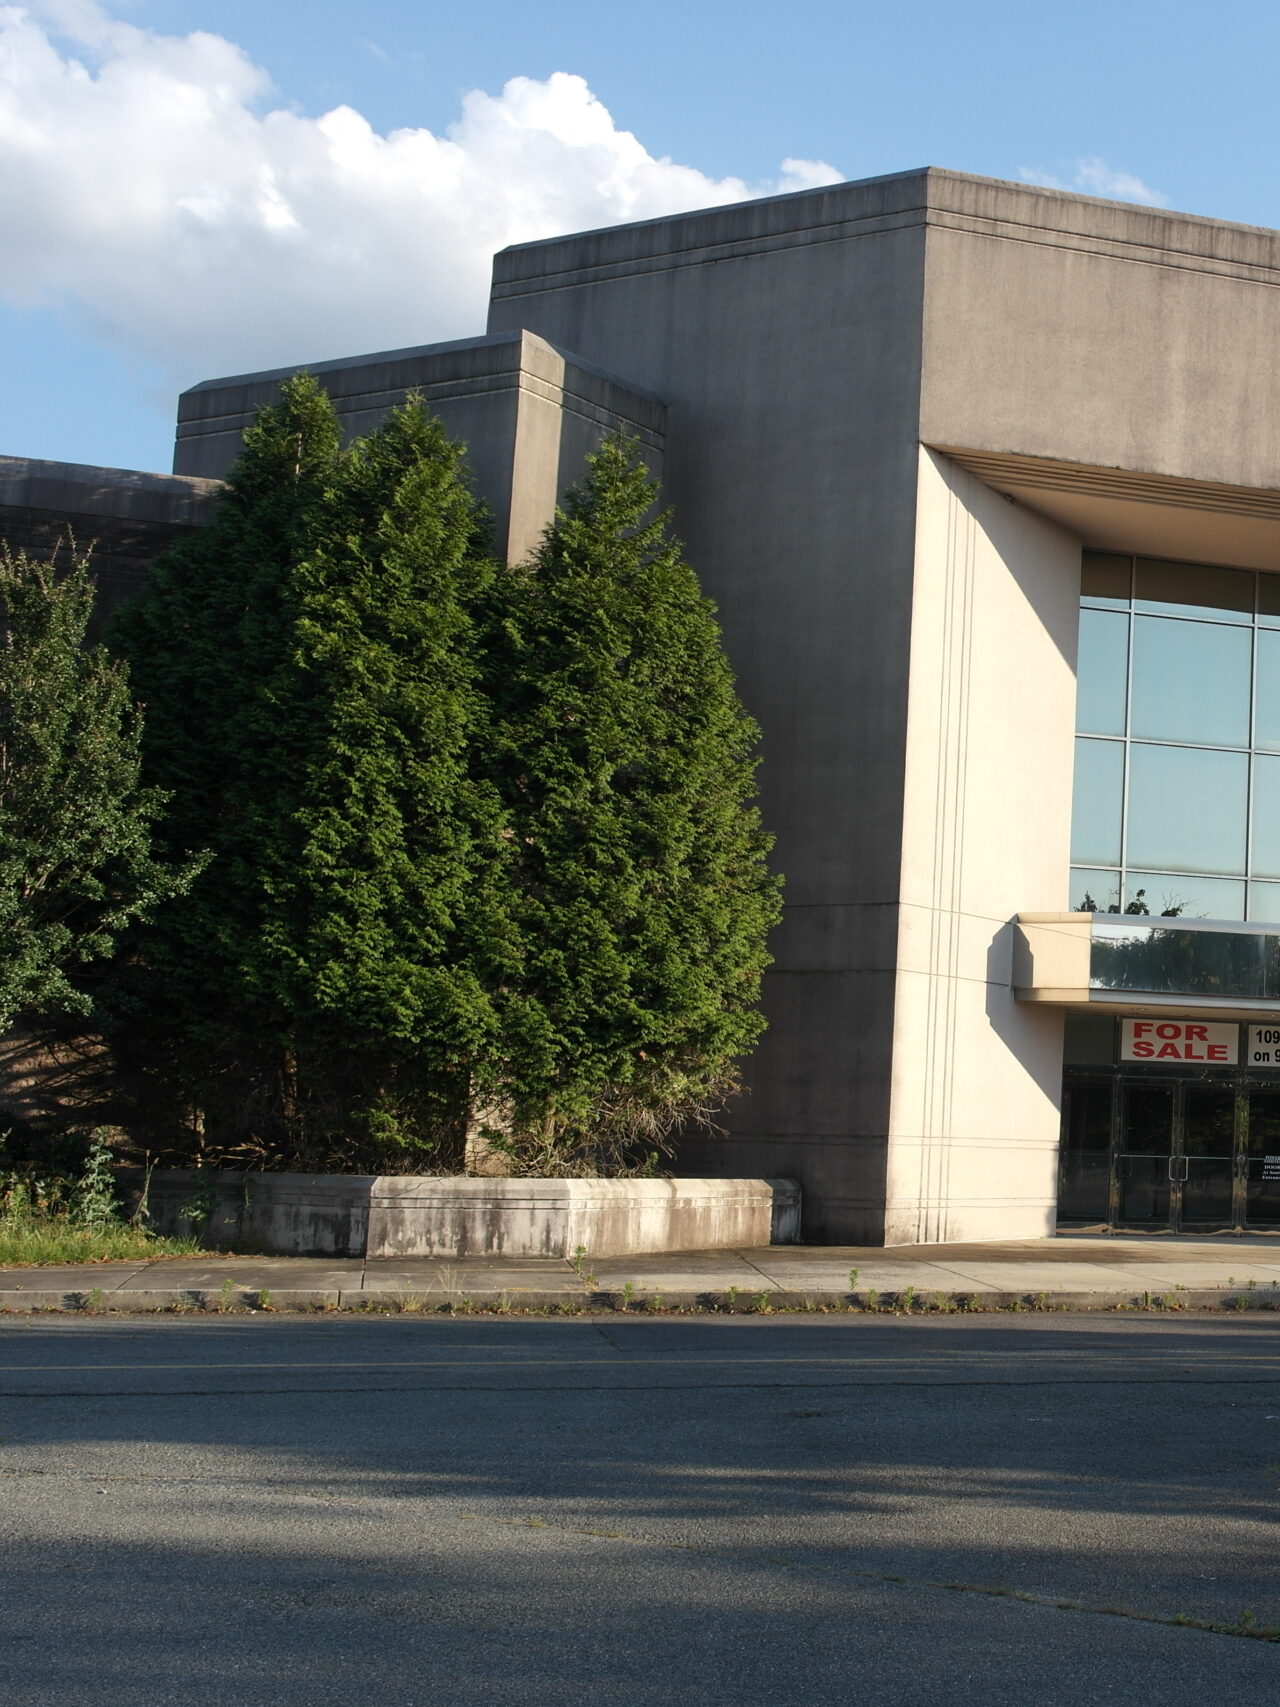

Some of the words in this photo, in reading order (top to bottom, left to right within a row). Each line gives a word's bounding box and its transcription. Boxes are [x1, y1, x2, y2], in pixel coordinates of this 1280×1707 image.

[1133, 1022, 1209, 1041] FOR
[1132, 1041, 1229, 1061] SALE
[1253, 1051, 1270, 1062] on
